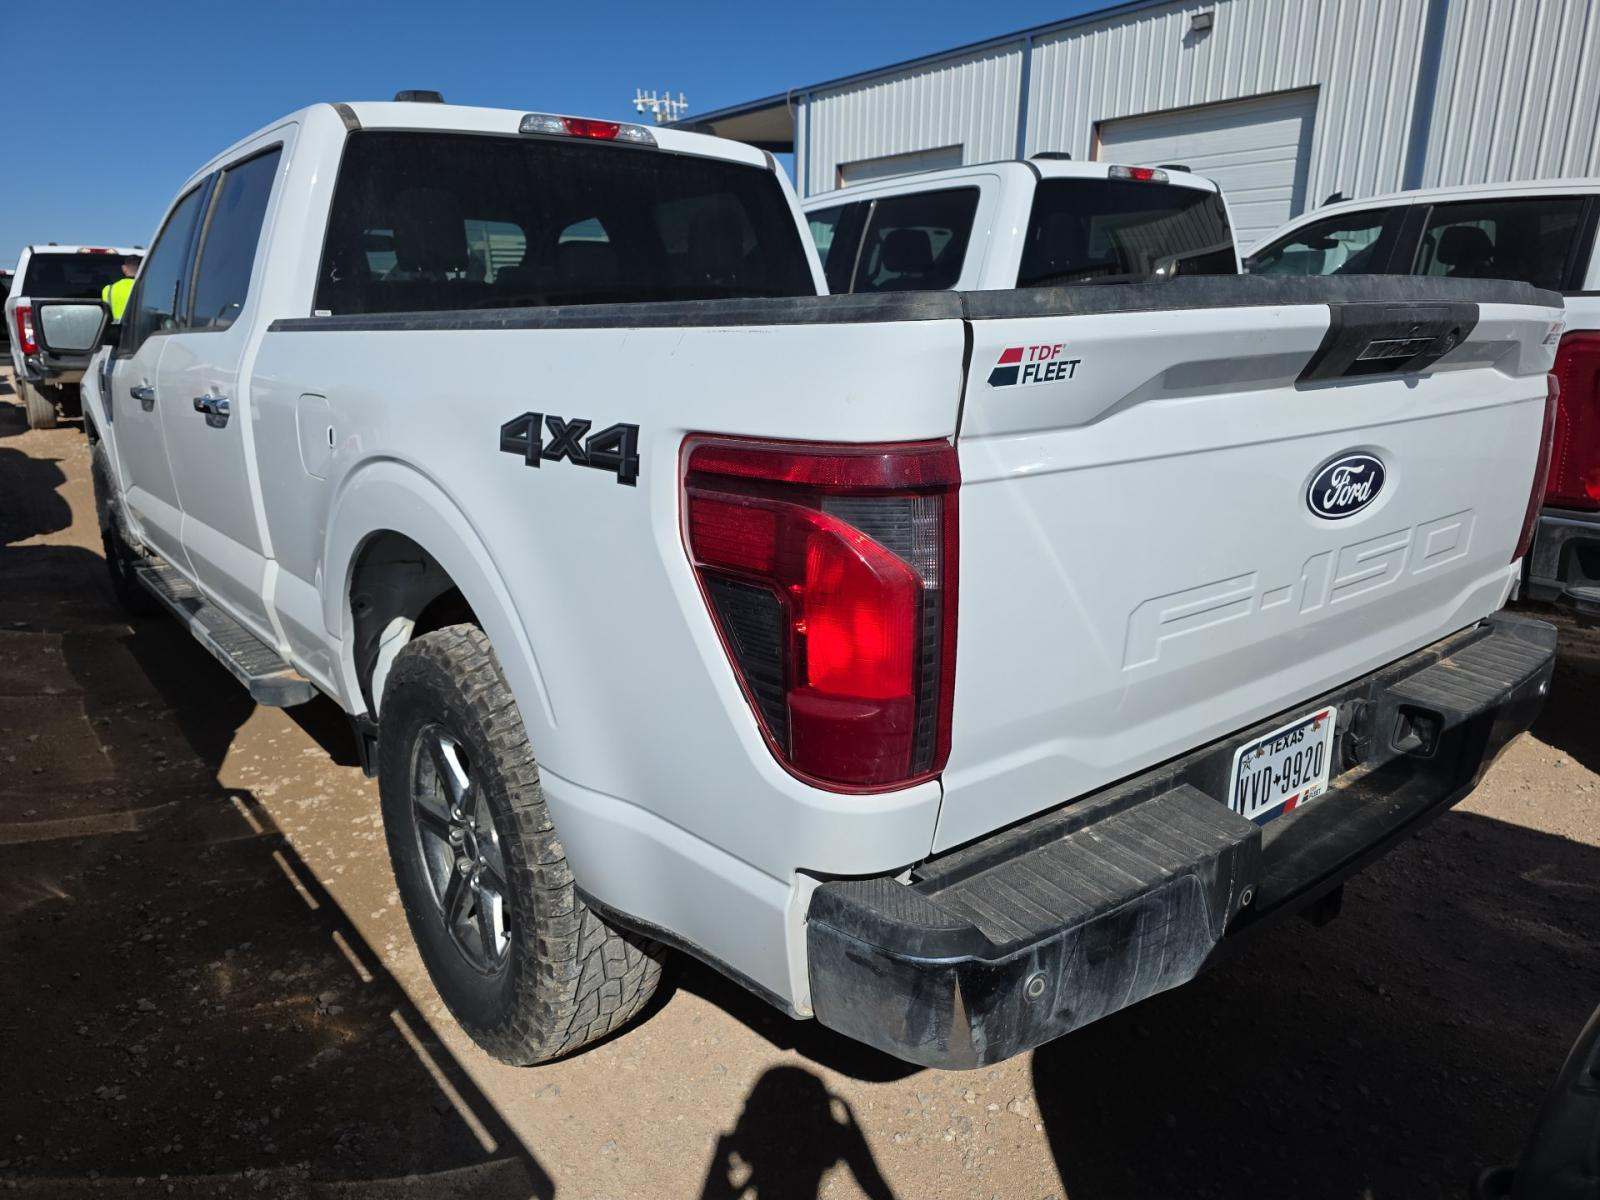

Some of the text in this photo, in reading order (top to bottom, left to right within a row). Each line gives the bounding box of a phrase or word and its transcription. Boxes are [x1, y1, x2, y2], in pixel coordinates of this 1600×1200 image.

[1029, 344, 1063, 361] TDF
[1021, 359, 1082, 385] FLEET
[1323, 464, 1376, 510] Ford
[1121, 507, 1477, 672] F-150
[1269, 728, 1305, 756] TEXAS
